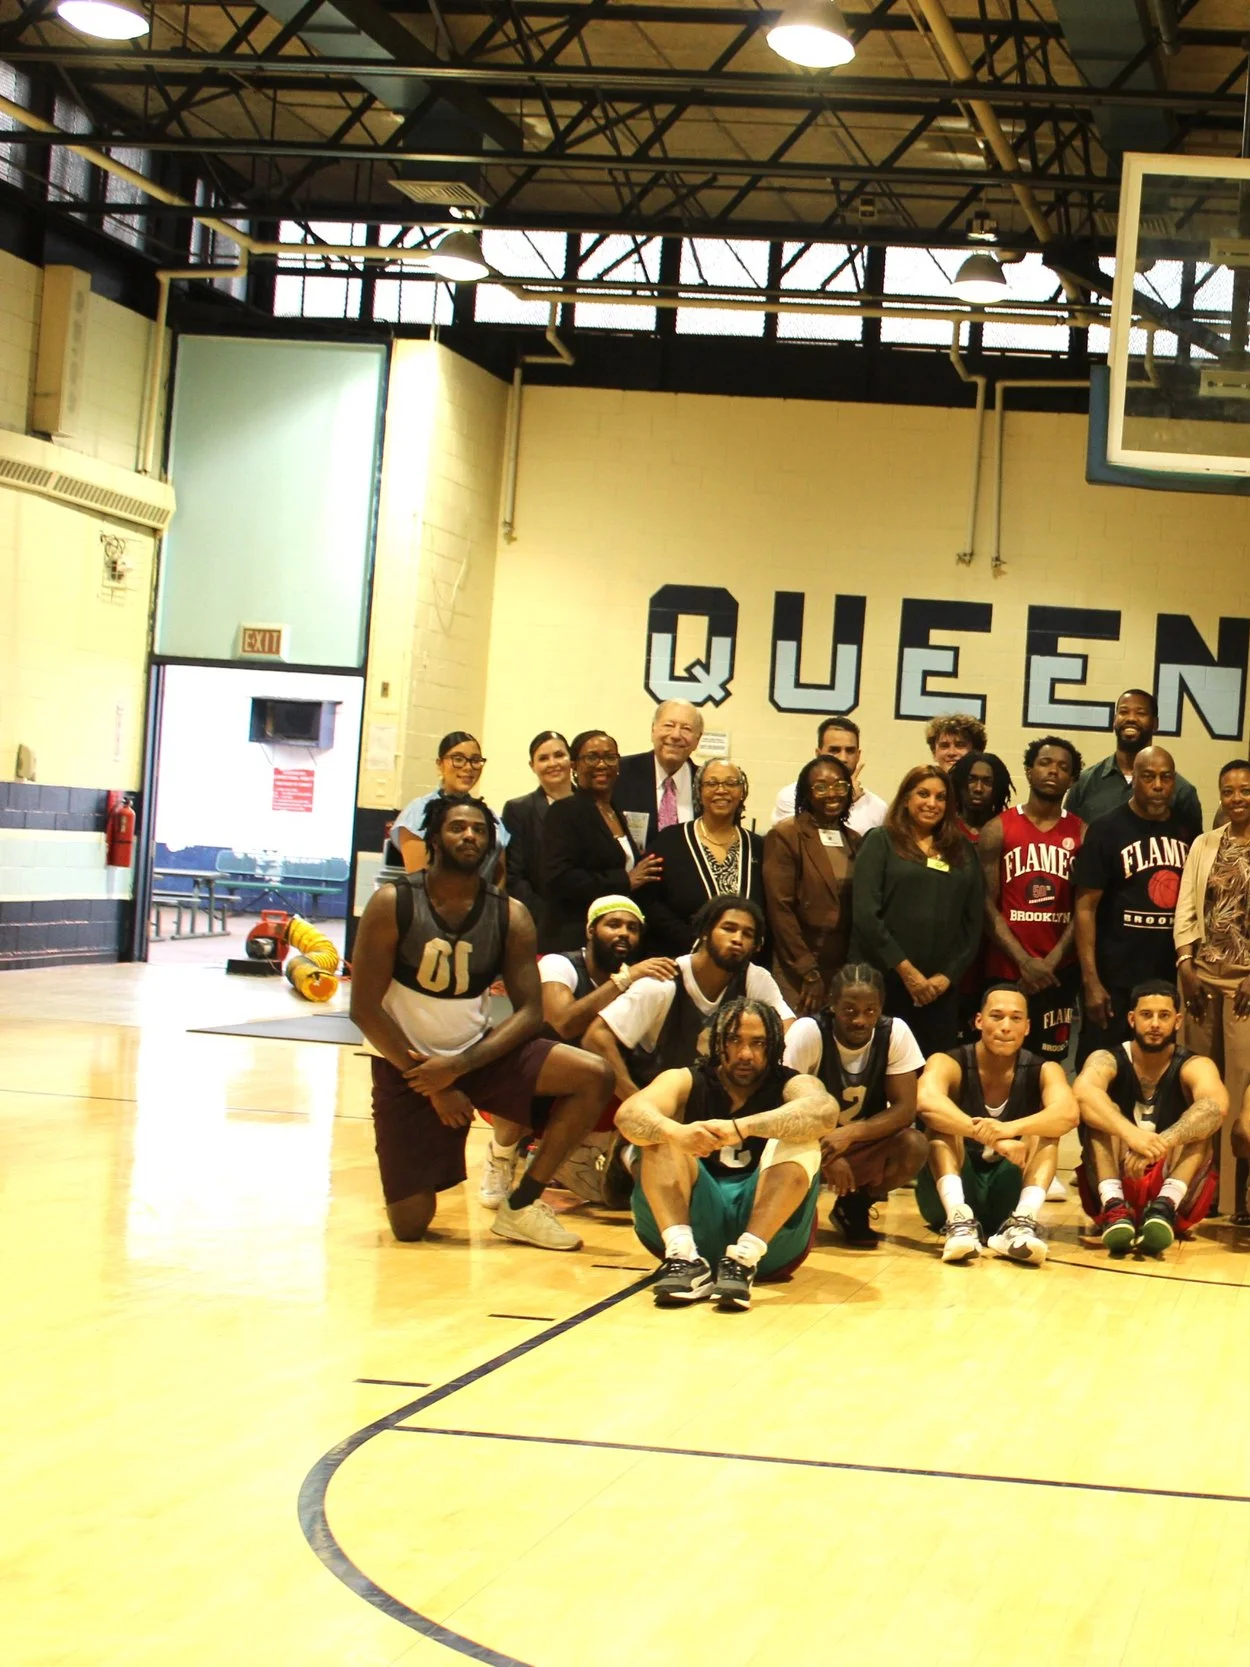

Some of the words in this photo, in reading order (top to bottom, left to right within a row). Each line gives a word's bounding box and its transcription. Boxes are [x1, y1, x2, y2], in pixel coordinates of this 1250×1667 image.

[244, 630, 281, 652] EXIT
[1121, 836, 1188, 879] FLAM
[1009, 909, 1071, 923] BROOKLYN
[1123, 914, 1174, 925] BROO
[1043, 1007, 1073, 1030] FLAM
